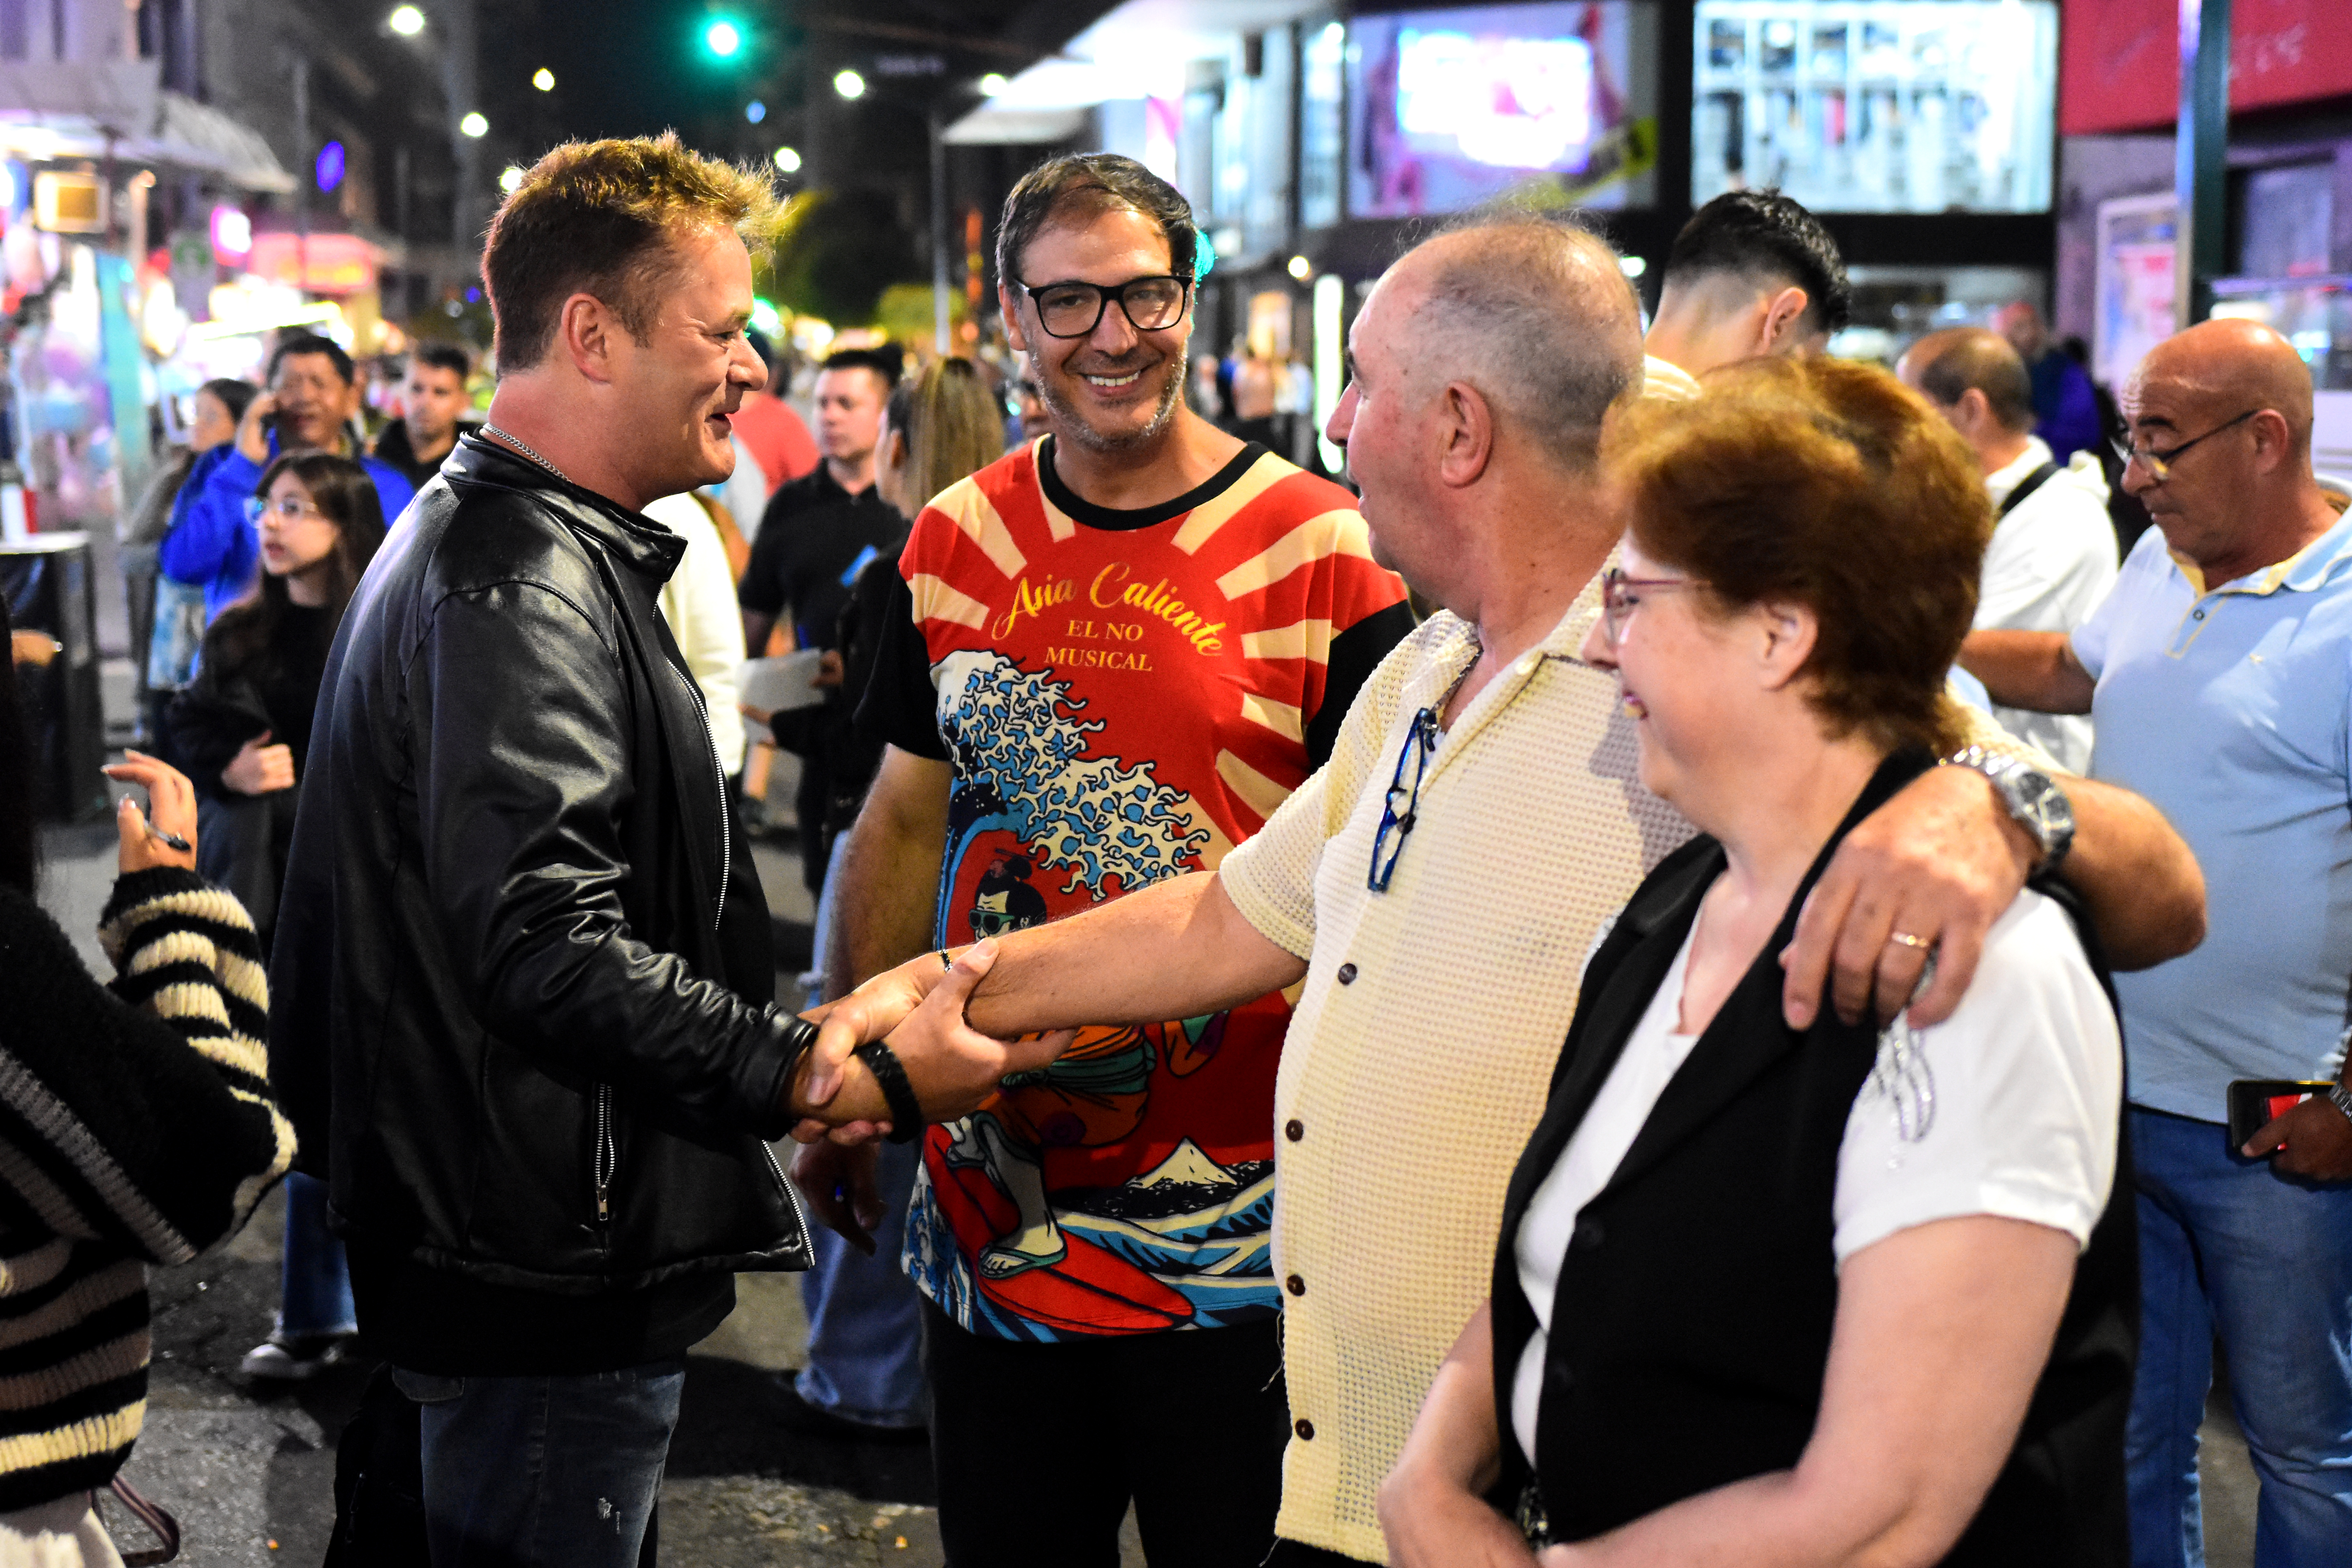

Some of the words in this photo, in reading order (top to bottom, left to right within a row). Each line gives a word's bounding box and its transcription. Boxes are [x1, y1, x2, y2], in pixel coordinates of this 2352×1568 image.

[991, 574, 1078, 640] Asia
[1089, 561, 1226, 657] Caliente
[1065, 619, 1099, 638] EL
[1105, 622, 1143, 641] NO
[1044, 647, 1153, 672] MUSICAL
